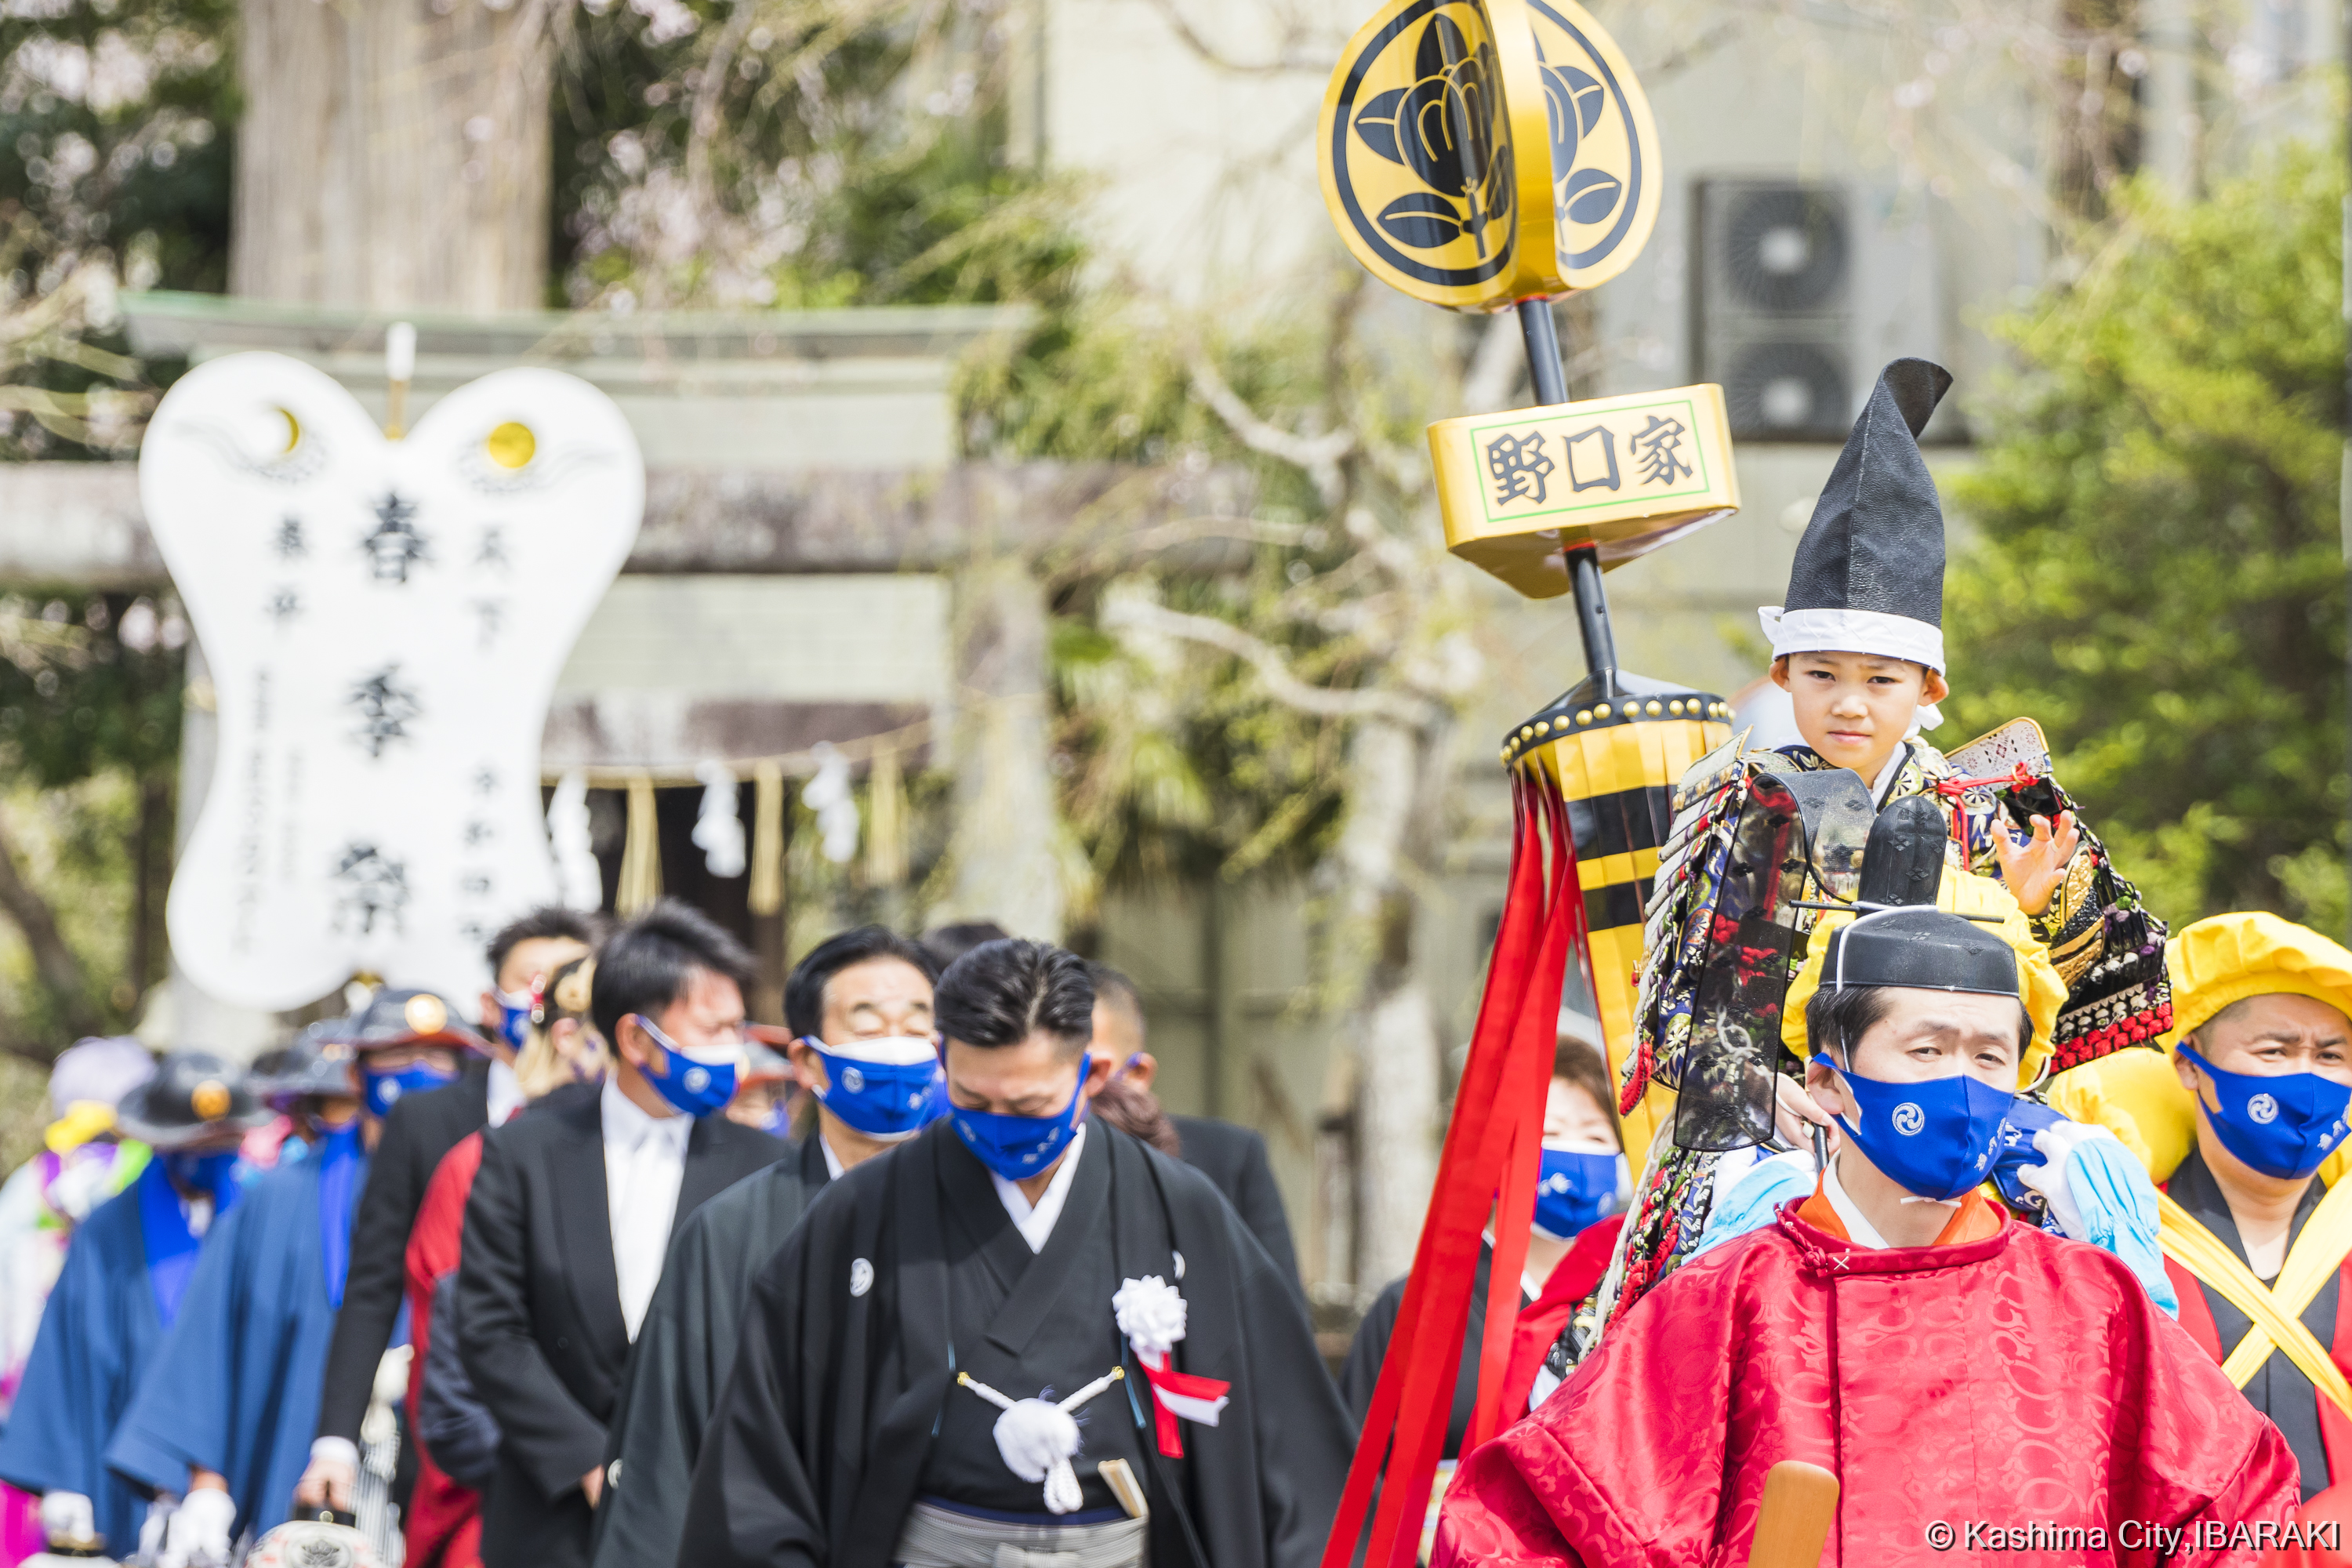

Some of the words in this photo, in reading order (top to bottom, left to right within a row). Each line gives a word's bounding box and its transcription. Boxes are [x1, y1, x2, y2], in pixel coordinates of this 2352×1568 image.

[1486, 416, 1693, 506] 野口家
[332, 491, 433, 933] 春季祭
